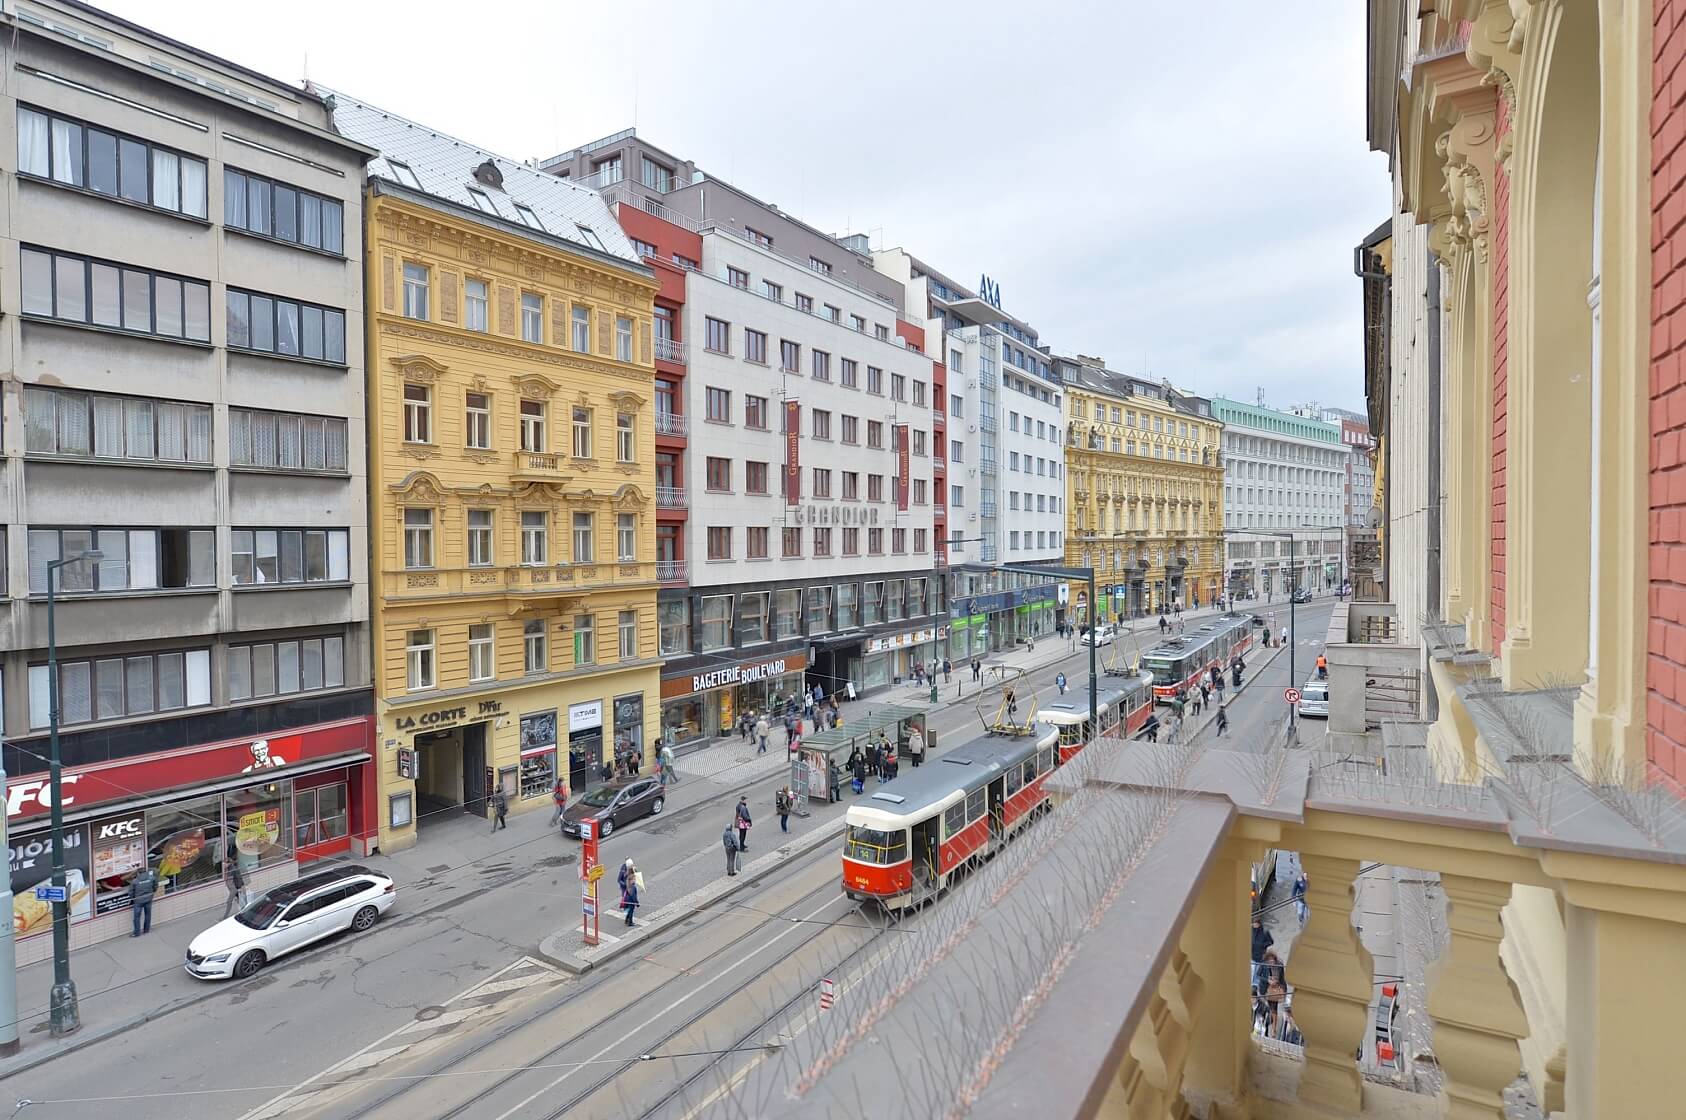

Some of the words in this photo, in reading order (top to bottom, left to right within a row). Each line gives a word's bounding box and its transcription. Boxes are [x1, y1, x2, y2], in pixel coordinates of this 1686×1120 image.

[980, 273, 1001, 311] AXA
[795, 505, 878, 526] GRANDIOR
[693, 666, 740, 691] BAGETERIE
[741, 660, 785, 684] BOULEVARD
[396, 716, 416, 730] LA
[419, 707, 466, 725] CORTE
[7, 776, 78, 817] FC
[99, 819, 142, 839] KFC
